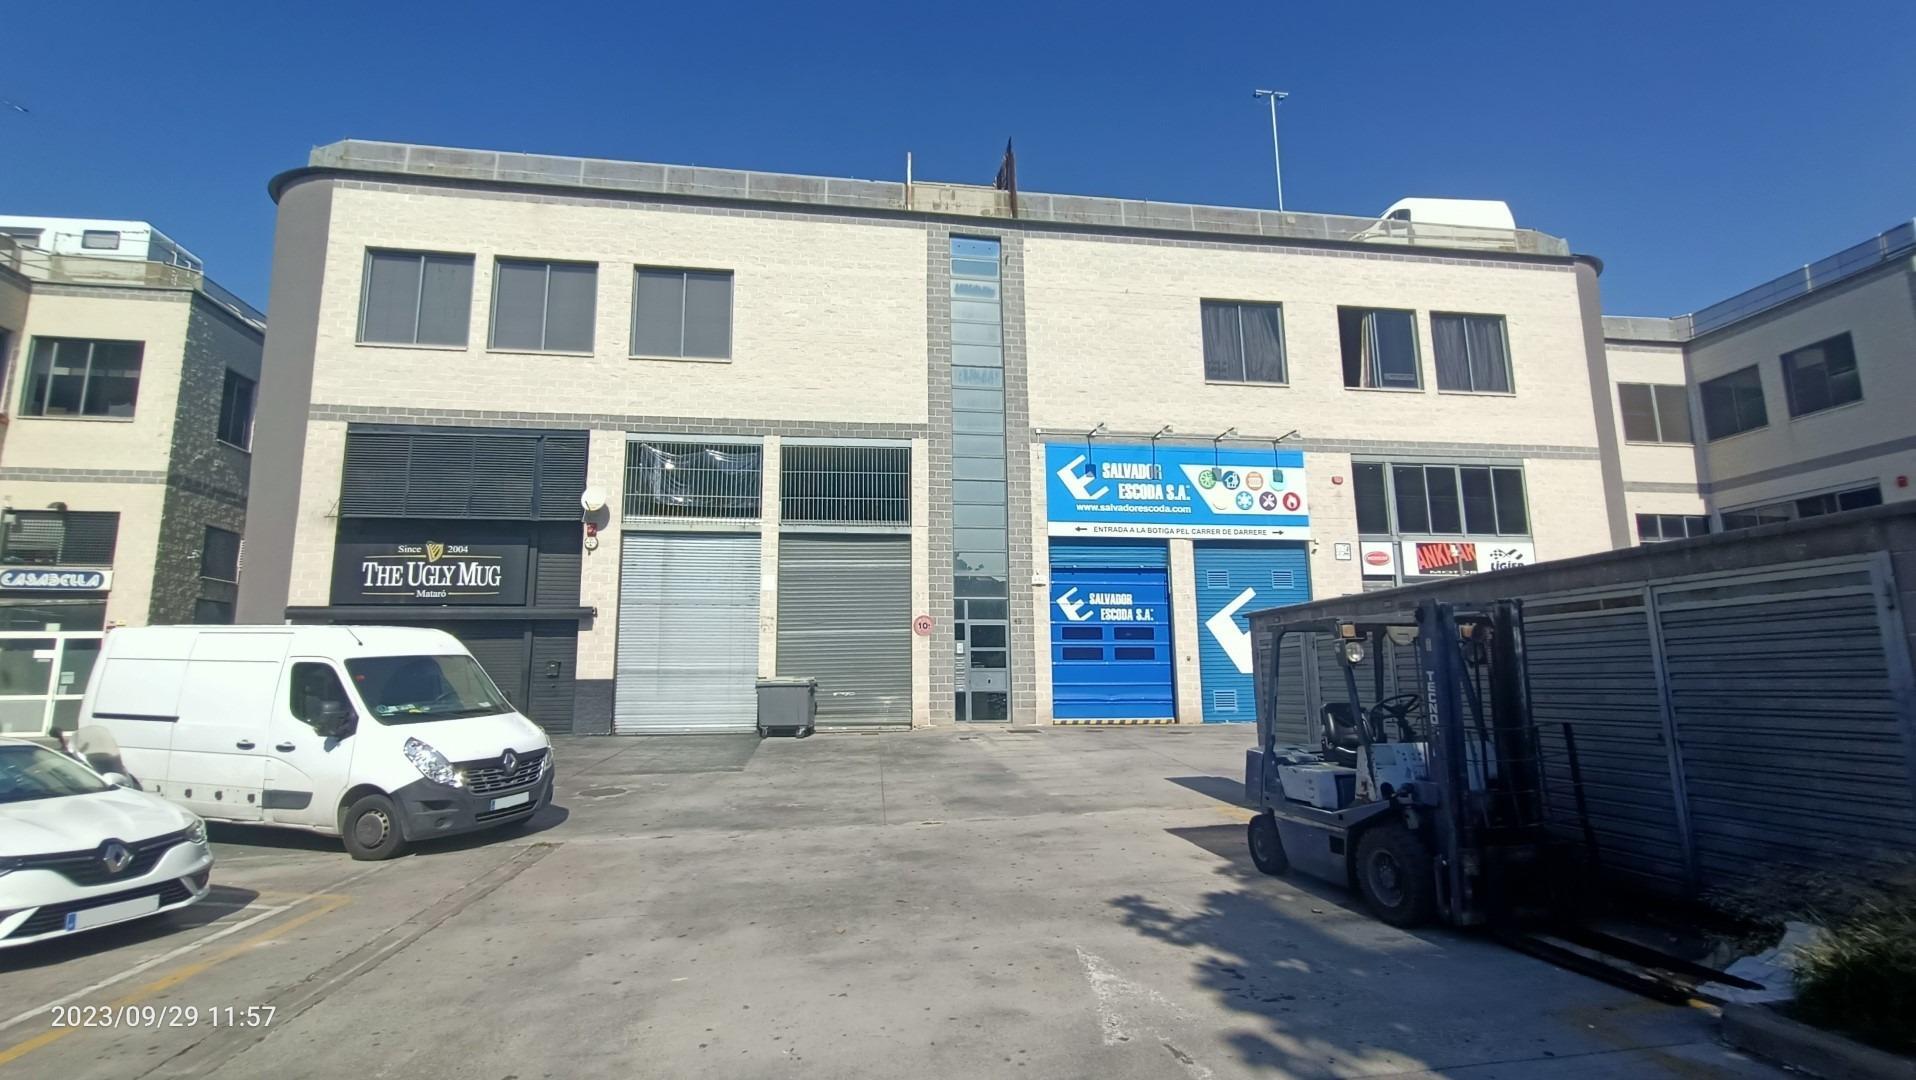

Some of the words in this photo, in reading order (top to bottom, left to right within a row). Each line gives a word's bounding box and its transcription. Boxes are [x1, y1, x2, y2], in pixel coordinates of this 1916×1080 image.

[1101, 462, 1161, 480] SALVADOR
[1118, 483, 1164, 500] ESCODA
[1076, 504, 1192, 513] www.salvadorescoda.com
[1147, 527, 1175, 535] BOTIGA
[398, 545, 422, 553] Since
[447, 545, 469, 553] 2004
[1, 572, 101, 588] CASABELLA
[415, 589, 447, 598] Mataró
[1089, 592, 1133, 605] SALVADOR
[1100, 608, 1134, 621] ESCODA
[1426, 670, 1440, 725] TECNO
